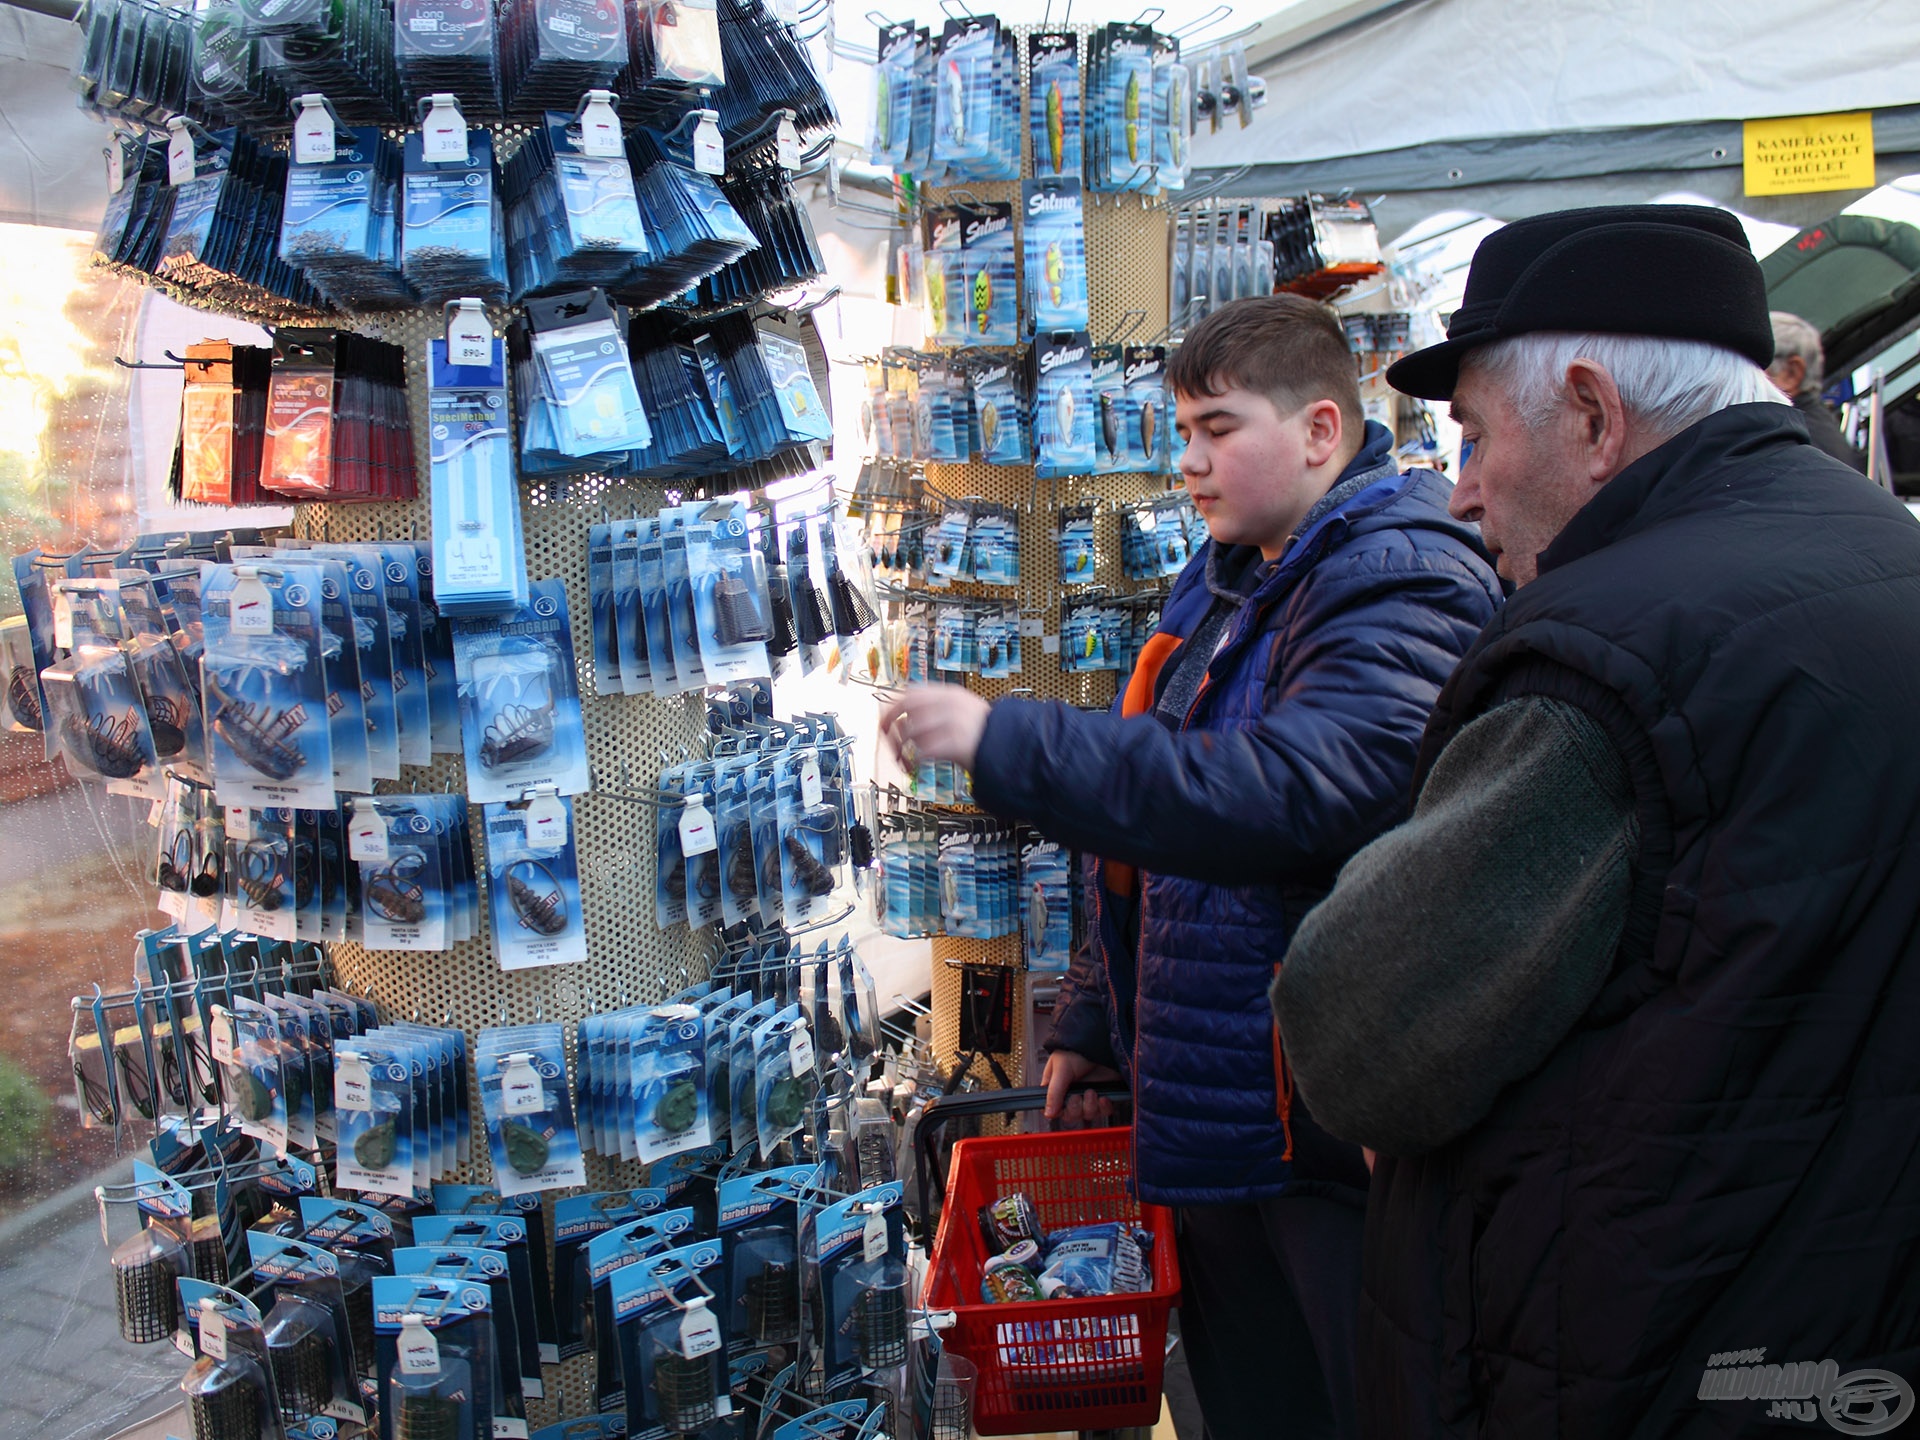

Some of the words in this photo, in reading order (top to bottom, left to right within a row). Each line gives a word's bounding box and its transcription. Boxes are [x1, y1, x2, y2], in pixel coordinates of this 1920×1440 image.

[416, 8, 444, 21] Long
[555, 9, 581, 26] Long
[440, 22, 466, 32] Cast
[576, 27, 601, 41] Cast
[1028, 193, 1078, 216] Salmo
[966, 216, 1007, 241] Salmo
[1040, 348, 1085, 374] Salmo
[974, 366, 1008, 388] Salmo
[1125, 360, 1160, 384] Salmo
[432, 411, 496, 423] SpeciMethod
[501, 619, 560, 638] PROGRAM
[939, 832, 970, 850] Salmo
[1021, 840, 1060, 862] Salmo
[722, 1206, 749, 1221] Barbel
[749, 1202, 772, 1216] River
[558, 1222, 588, 1237] Barbel
[589, 1220, 611, 1231] Rive
[820, 1235, 842, 1255] Barbel
[594, 1259, 622, 1279] Barbel
[617, 1293, 649, 1315] Barbel
